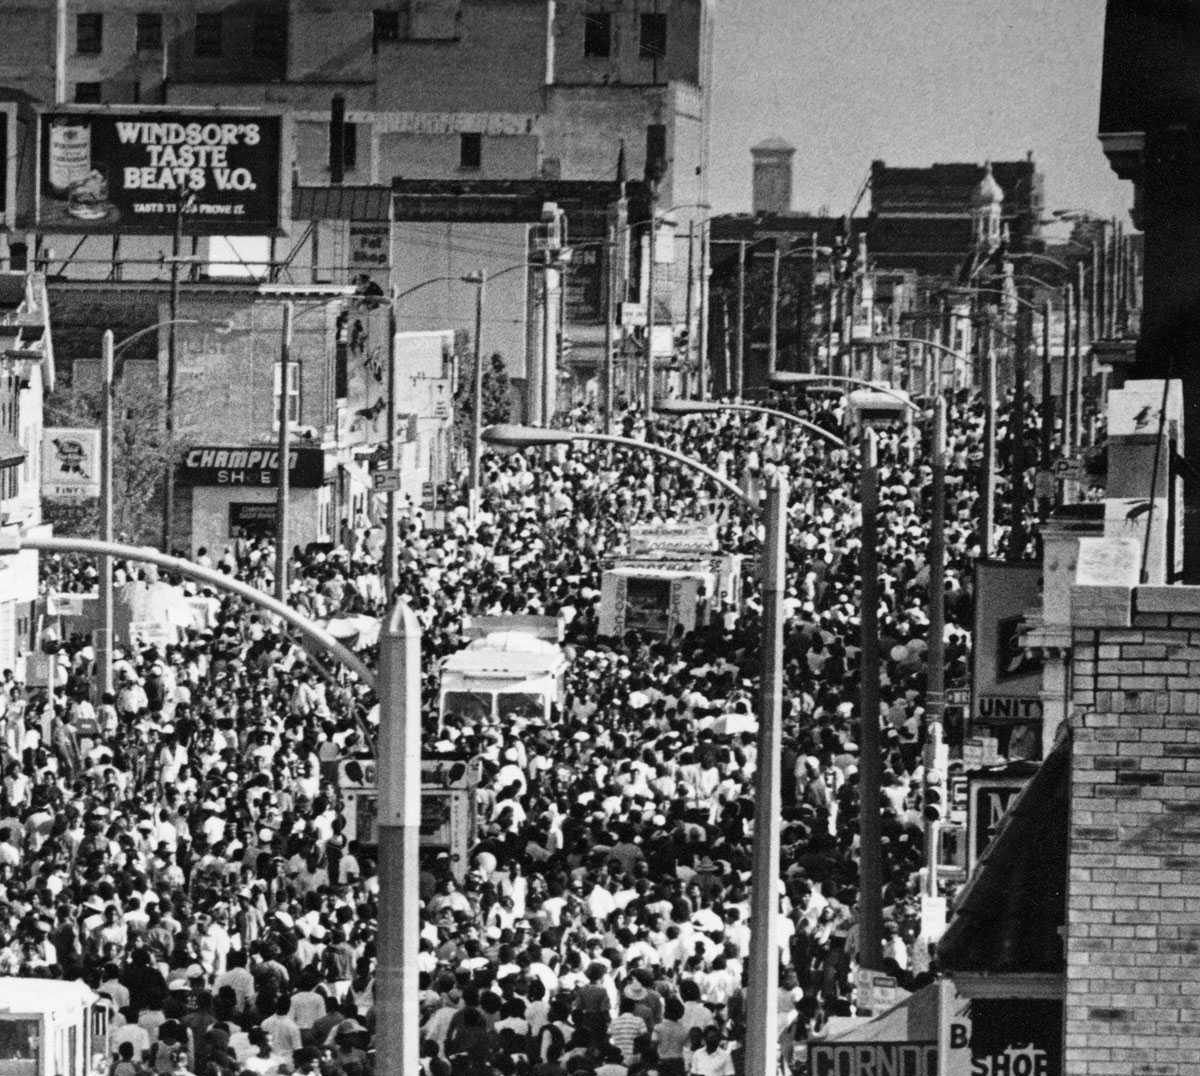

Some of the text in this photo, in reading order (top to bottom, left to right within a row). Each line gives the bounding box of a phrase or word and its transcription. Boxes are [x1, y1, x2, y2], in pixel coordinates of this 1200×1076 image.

[115, 121, 261, 145] WINDSOR'S
[146, 145, 228, 168] TASTE
[123, 167, 257, 190] BEATS V.O.
